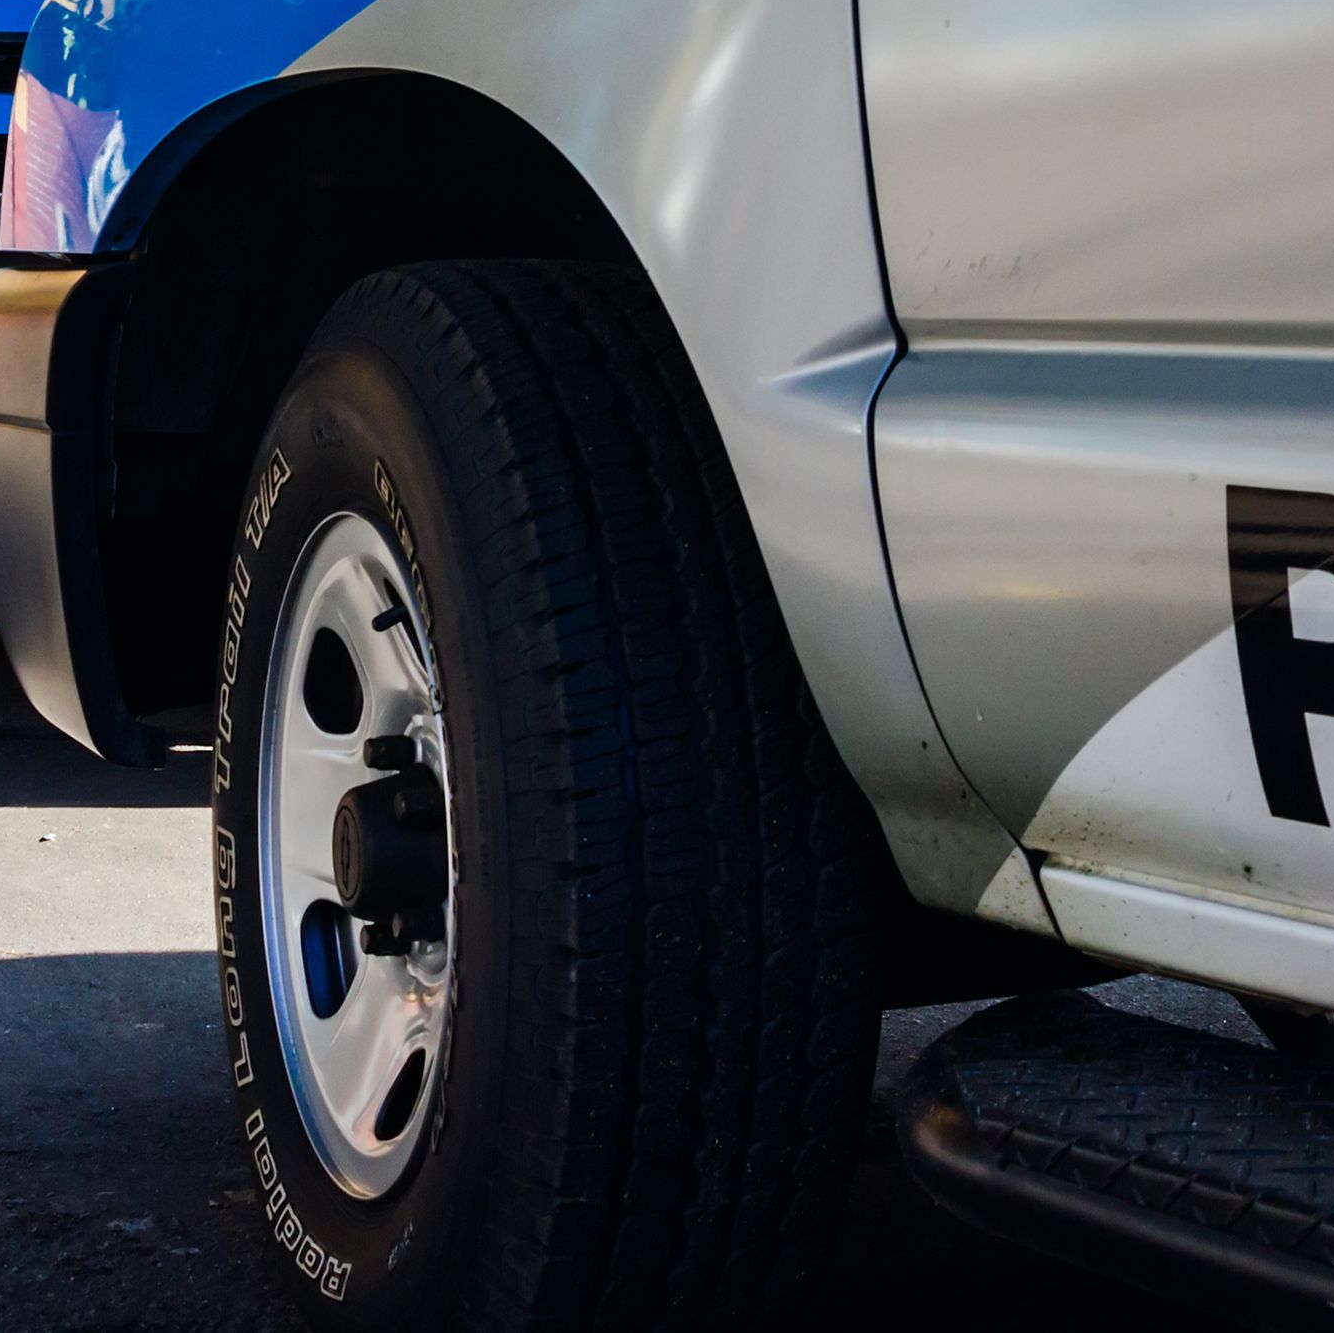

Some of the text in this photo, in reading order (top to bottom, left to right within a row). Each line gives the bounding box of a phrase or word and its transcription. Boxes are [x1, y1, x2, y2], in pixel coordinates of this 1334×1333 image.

[213, 446, 353, 1303] Radial Long Trail T/A
